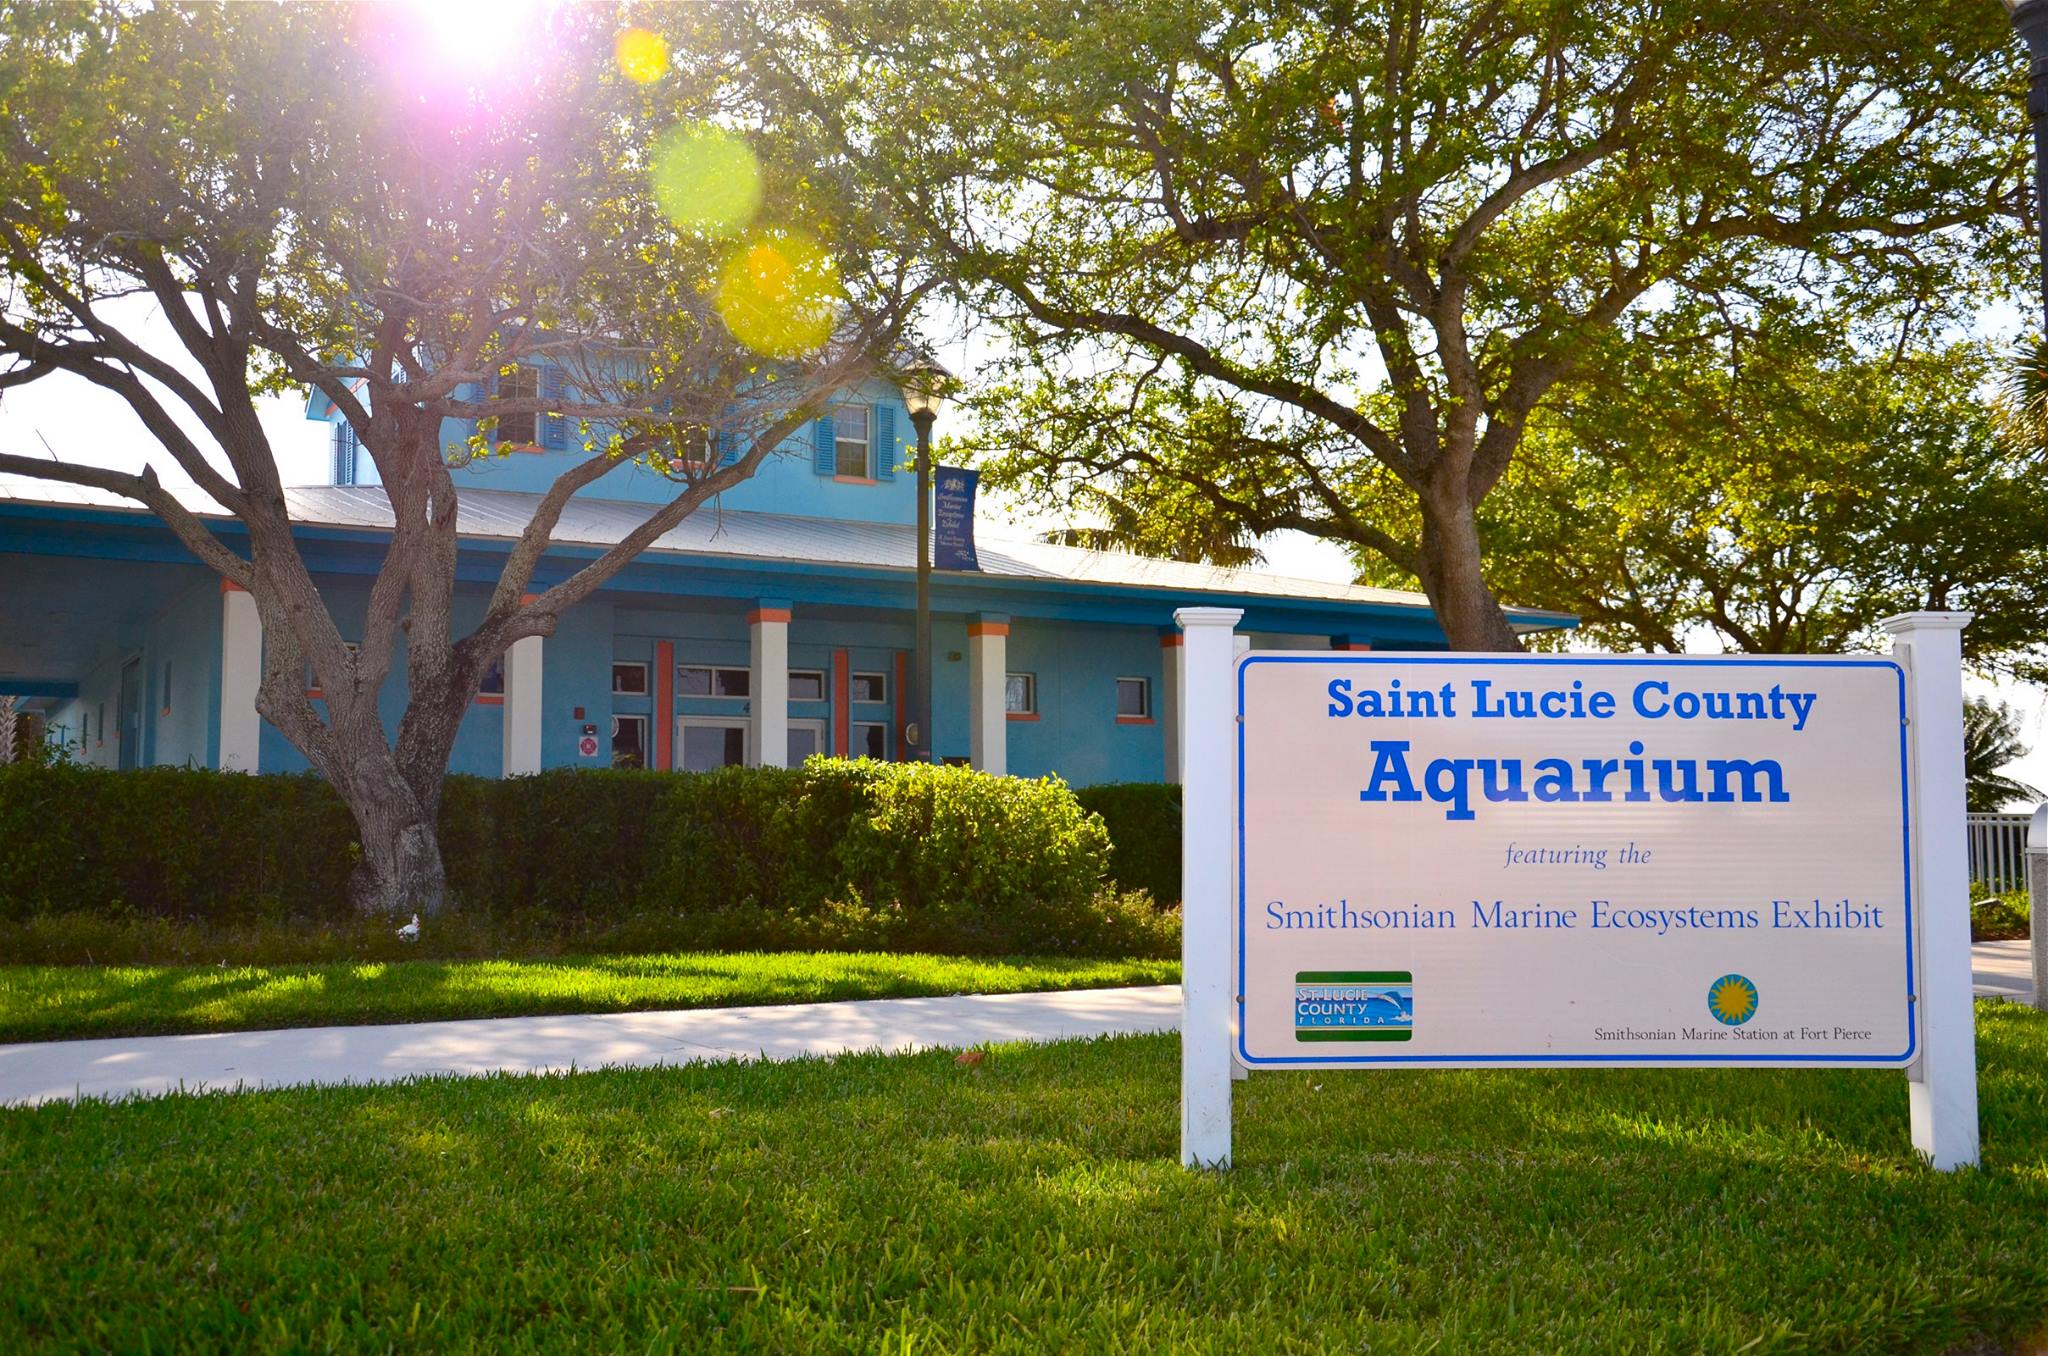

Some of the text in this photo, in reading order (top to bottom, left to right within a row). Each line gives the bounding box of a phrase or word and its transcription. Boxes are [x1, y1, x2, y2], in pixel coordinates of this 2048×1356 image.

[1328, 679, 1817, 731] Saint Lucie County
[1360, 741, 1790, 820] Aquarium
[1504, 842, 1652, 870] featuring the
[1266, 899, 1885, 936] Smithsonian Marine Ecosystems Exhibit
[1298, 1002, 1367, 1015] COUNTY
[1323, 988, 1368, 1001] LUCIE
[1594, 1026, 1872, 1041] Smithsonian Marine Station at Fort Pierce
